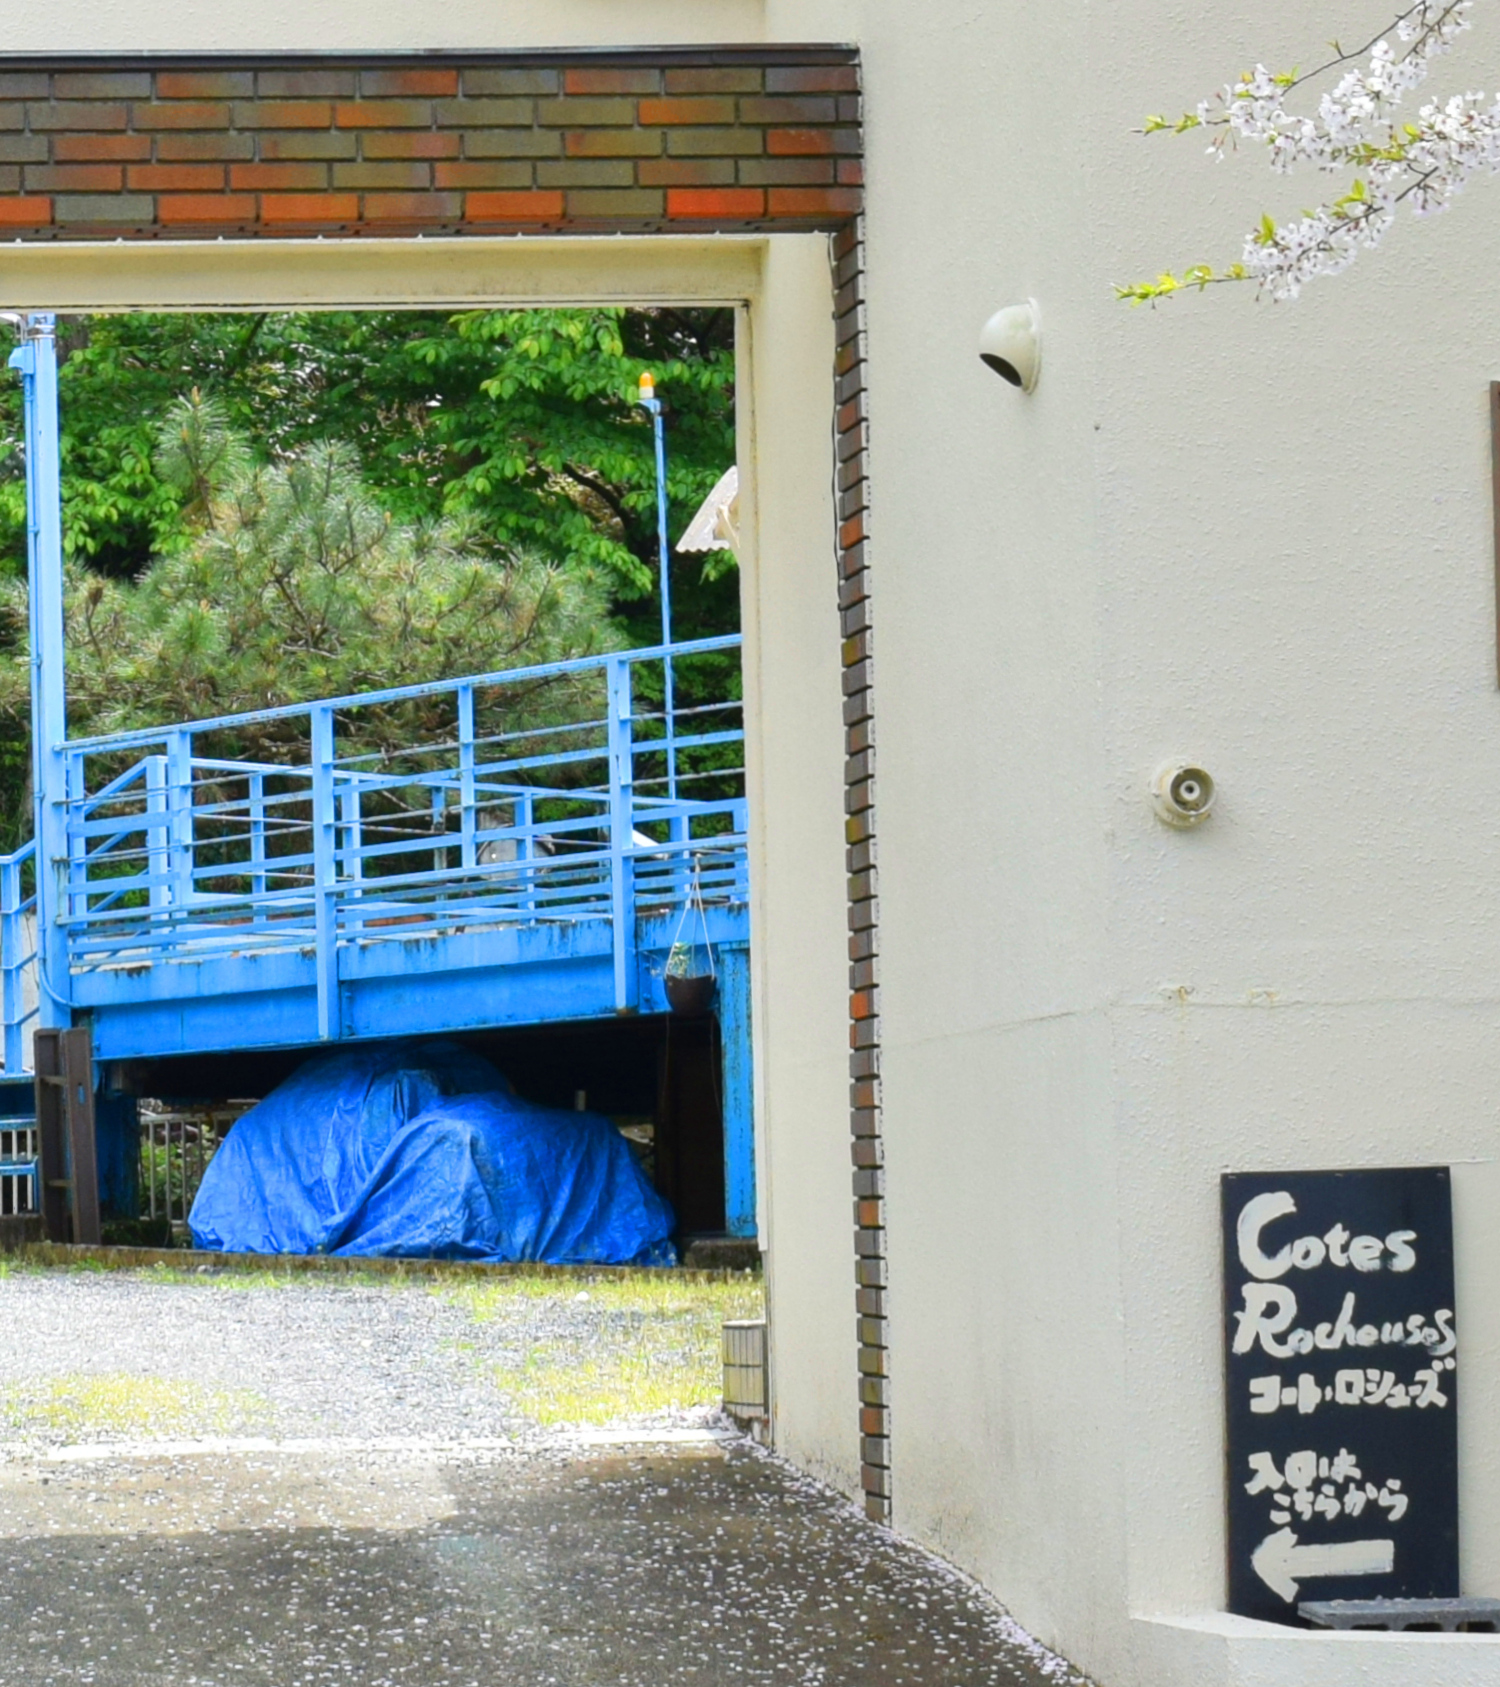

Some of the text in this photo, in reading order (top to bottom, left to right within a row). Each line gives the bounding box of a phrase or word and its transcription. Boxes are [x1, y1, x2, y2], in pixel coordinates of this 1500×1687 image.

[1237, 1191, 1417, 1280] Cotes
[1269, 1478, 1408, 1525] こちらから
